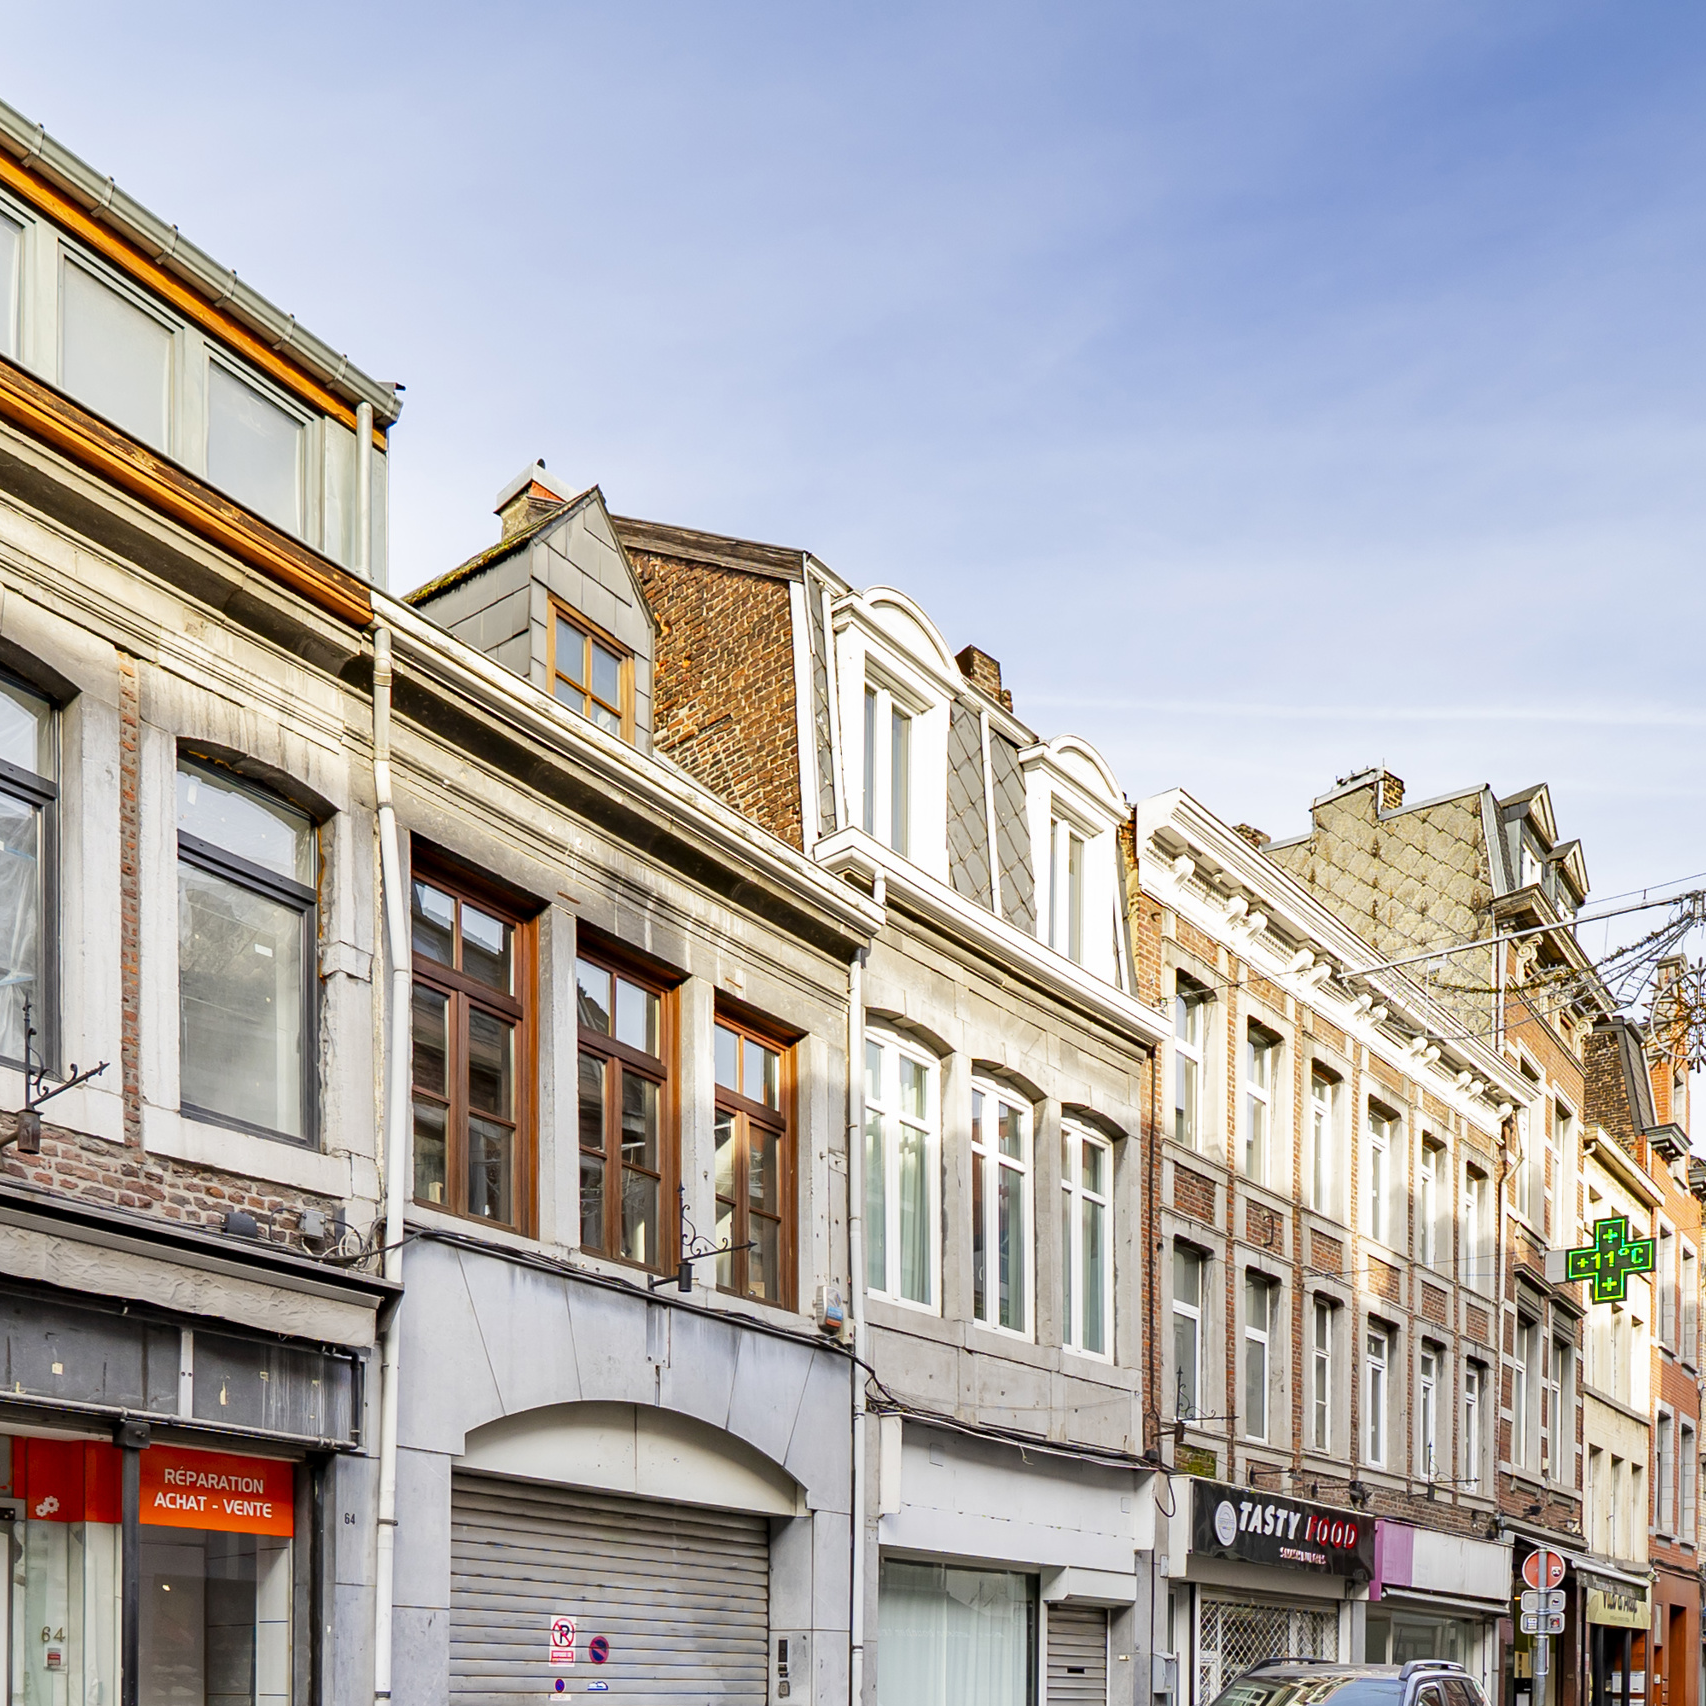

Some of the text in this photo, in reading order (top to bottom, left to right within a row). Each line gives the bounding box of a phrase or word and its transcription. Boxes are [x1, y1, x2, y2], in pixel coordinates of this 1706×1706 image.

[164, 1466, 264, 1494] RÉPARATION
[154, 1492, 207, 1512] ACHAT
[223, 1499, 272, 1518] VENTE
[345, 1512, 356, 1525] 64
[1239, 1501, 1358, 1549] TASTY FOOD
[41, 1626, 66, 1642] 64
